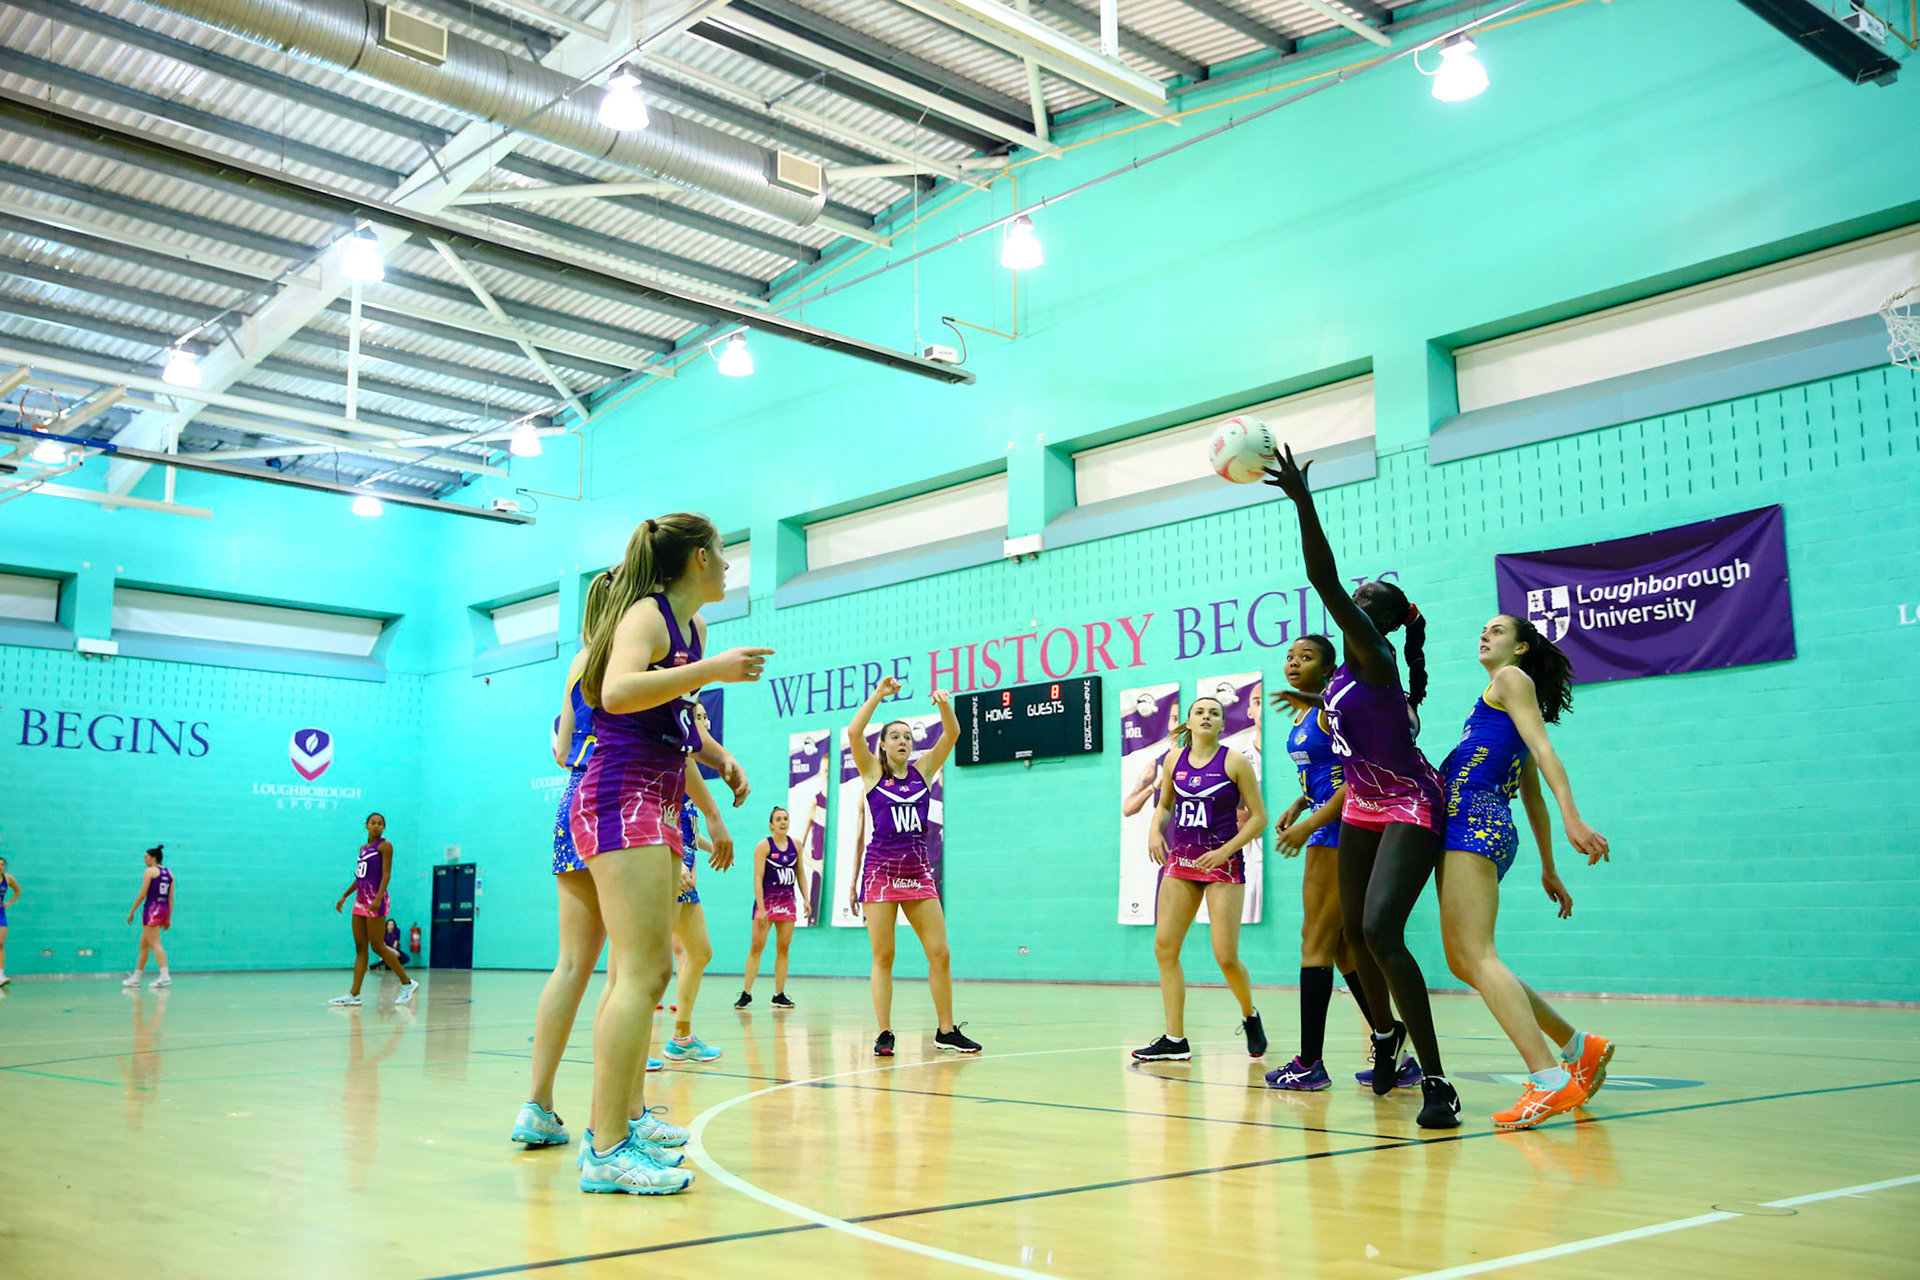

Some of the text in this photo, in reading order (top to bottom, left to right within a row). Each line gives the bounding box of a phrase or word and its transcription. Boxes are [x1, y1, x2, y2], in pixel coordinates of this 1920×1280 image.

[1576, 558, 1750, 604] Loughborough
[1578, 597, 1696, 630] University
[769, 571, 1399, 719] WHERE HISTORY BEGI
[1002, 691, 1011, 706] 9
[1050, 684, 1061, 699] 8
[985, 707, 1013, 722] HOME
[1027, 701, 1065, 717] GUESTS
[17, 708, 210, 758] BEGINS
[253, 783, 362, 799] LOUGHBOROUGH
[890, 805, 922, 833] WA
[1178, 800, 1209, 828] GA
[776, 867, 796, 885] WD
[892, 878, 922, 891] Vitality
